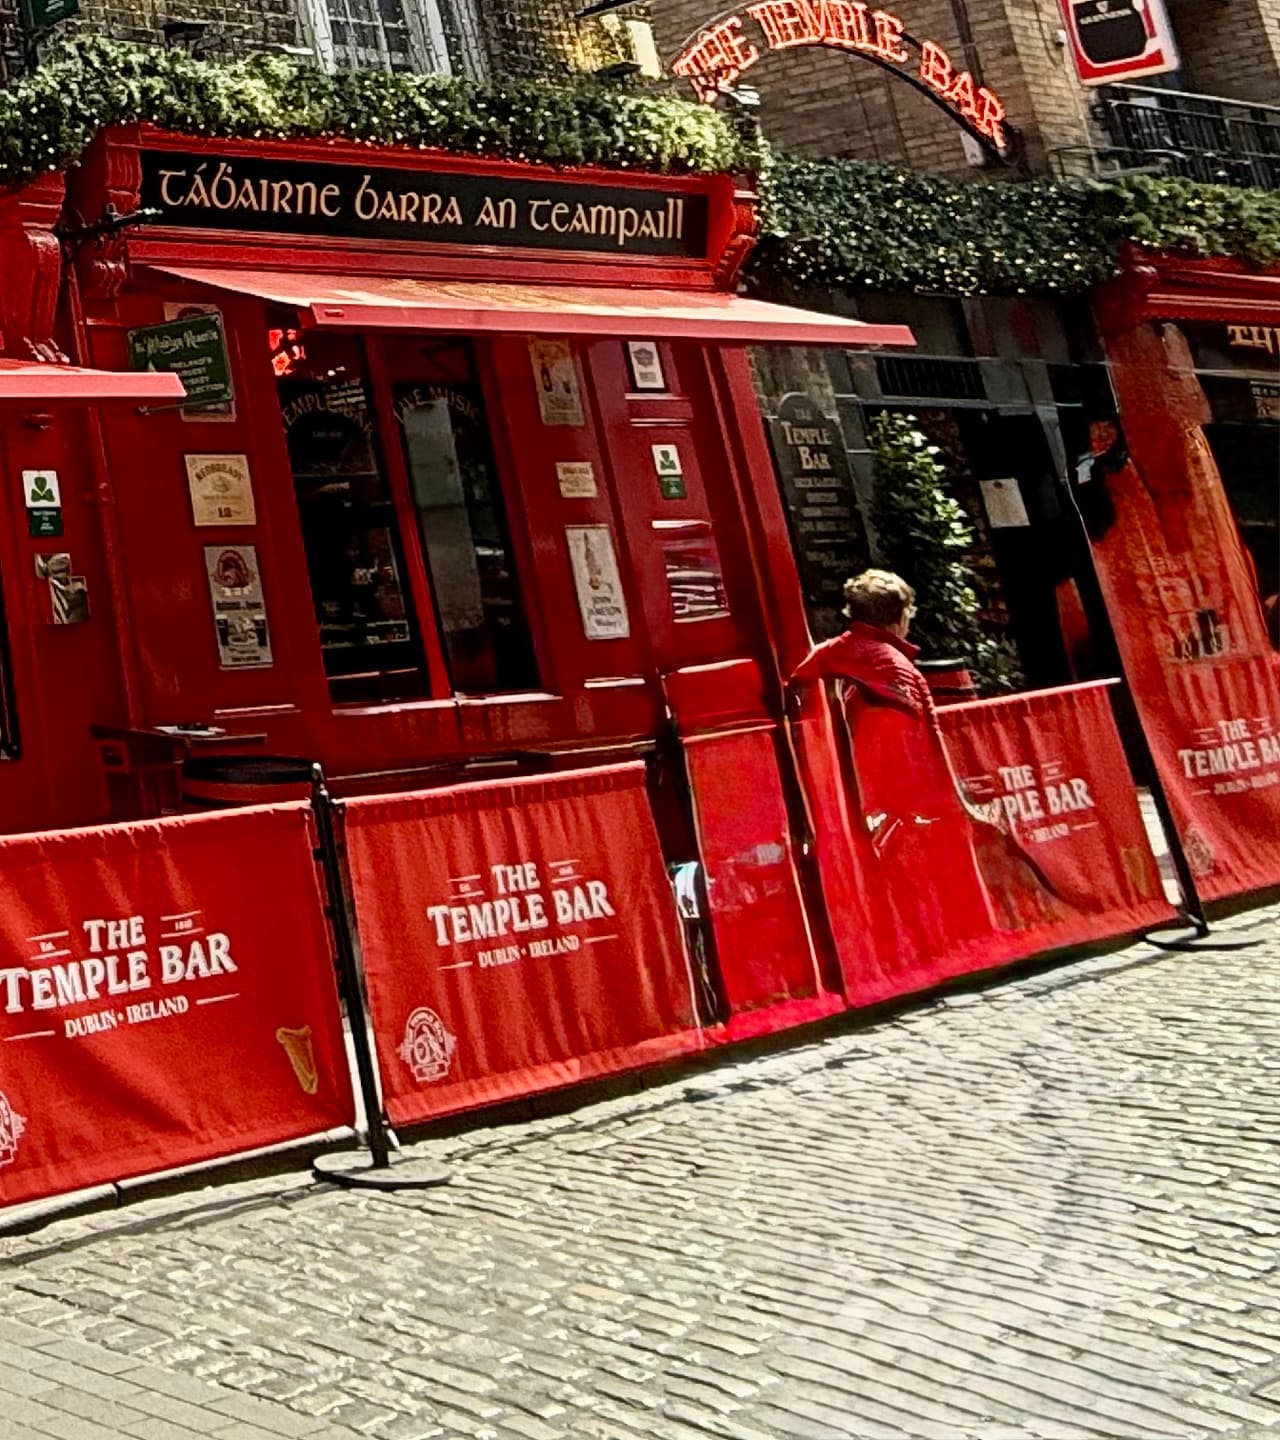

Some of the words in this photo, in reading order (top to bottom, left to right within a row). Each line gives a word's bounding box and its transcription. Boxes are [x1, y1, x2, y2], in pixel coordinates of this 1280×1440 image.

[920, 39, 1006, 149] BAR
[781, 421, 832, 445] TEMPLE
[798, 446, 832, 470] BAR
[1218, 718, 1252, 742] THE
[998, 764, 1037, 792] THE
[1177, 740, 1261, 779] TEMPLE
[1045, 777, 1096, 816] BAR
[492, 862, 541, 895] THE
[427, 893, 549, 947] TEMPLE
[552, 879, 617, 926] BAR
[83, 915, 147, 953] THE
[477, 944, 522, 969] DUBLIN
[528, 934, 581, 958] IRELAND
[159, 932, 239, 985] BAR
[64, 1008, 119, 1039] DUBLIN
[125, 994, 189, 1025] IRELAND
